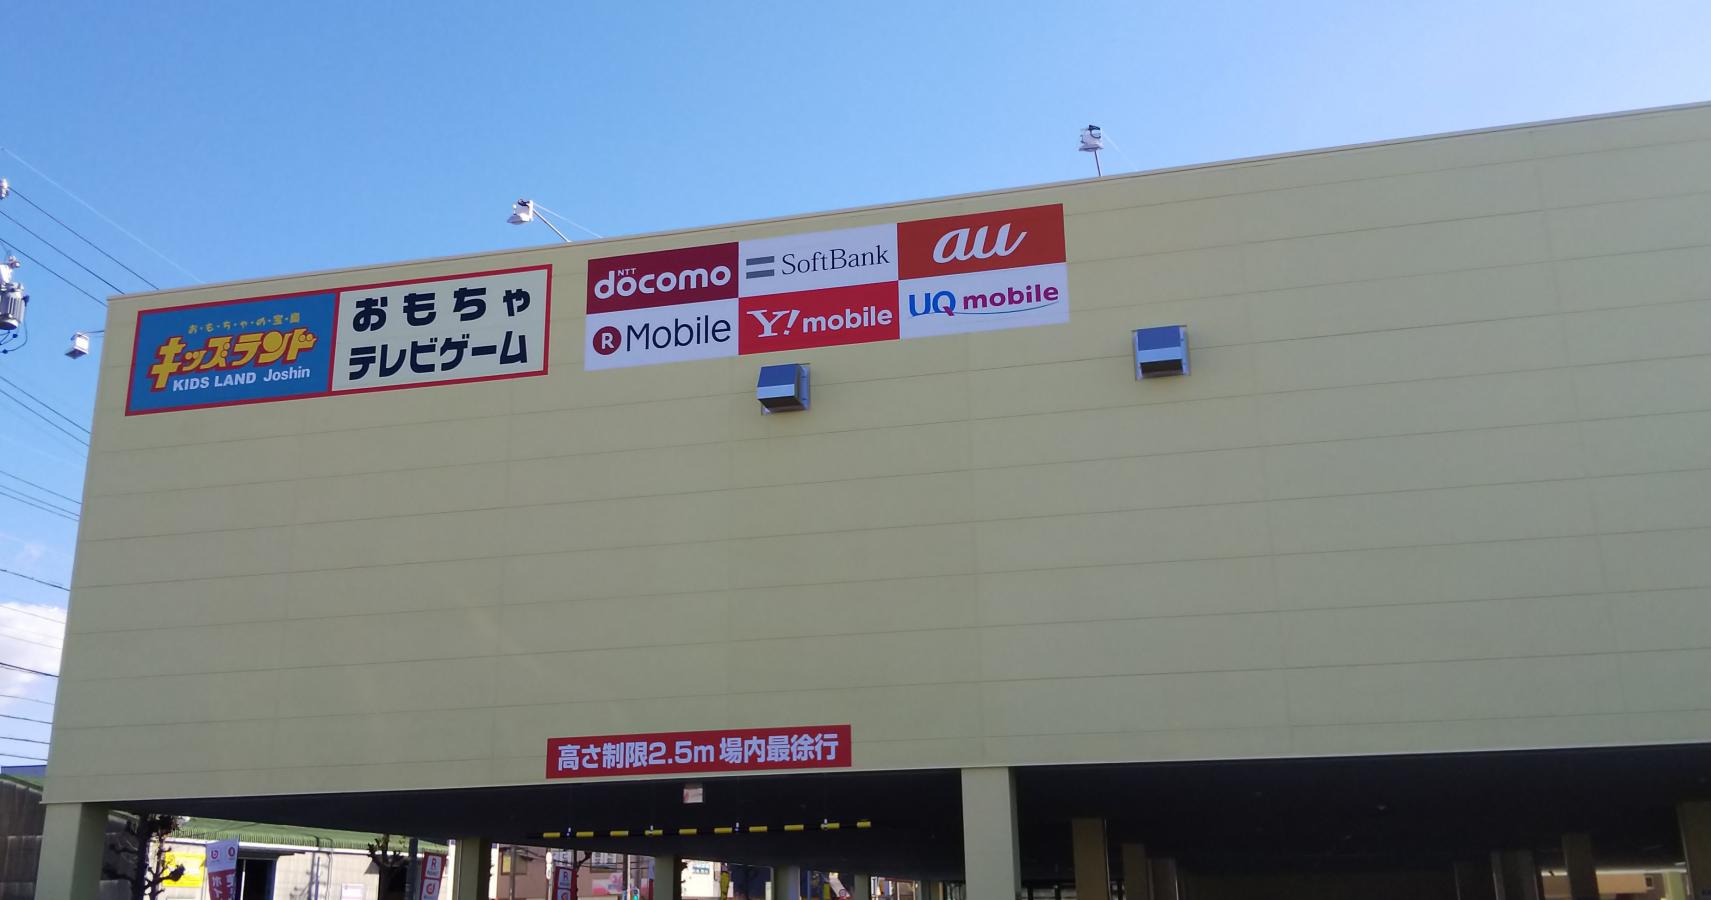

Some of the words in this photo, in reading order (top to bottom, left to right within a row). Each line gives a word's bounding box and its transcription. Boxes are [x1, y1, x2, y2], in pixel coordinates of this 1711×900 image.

[782, 245, 890, 276] SoftBank
[932, 223, 1028, 264] au
[594, 265, 731, 299] docomo
[617, 267, 637, 277] NTT
[353, 287, 531, 333] おもちゃ
[908, 290, 956, 316] UQ
[963, 284, 1059, 310] mobile
[627, 315, 732, 352] Mobile
[151, 327, 317, 389] キッズランド
[349, 331, 528, 381] テレビゲーム
[172, 376, 210, 392] KIDS
[214, 372, 257, 388] LAND
[263, 366, 311, 382] Joshin
[558, 740, 715, 771] 高さ制限2.5m
[719, 734, 839, 763] 場内最徐行
